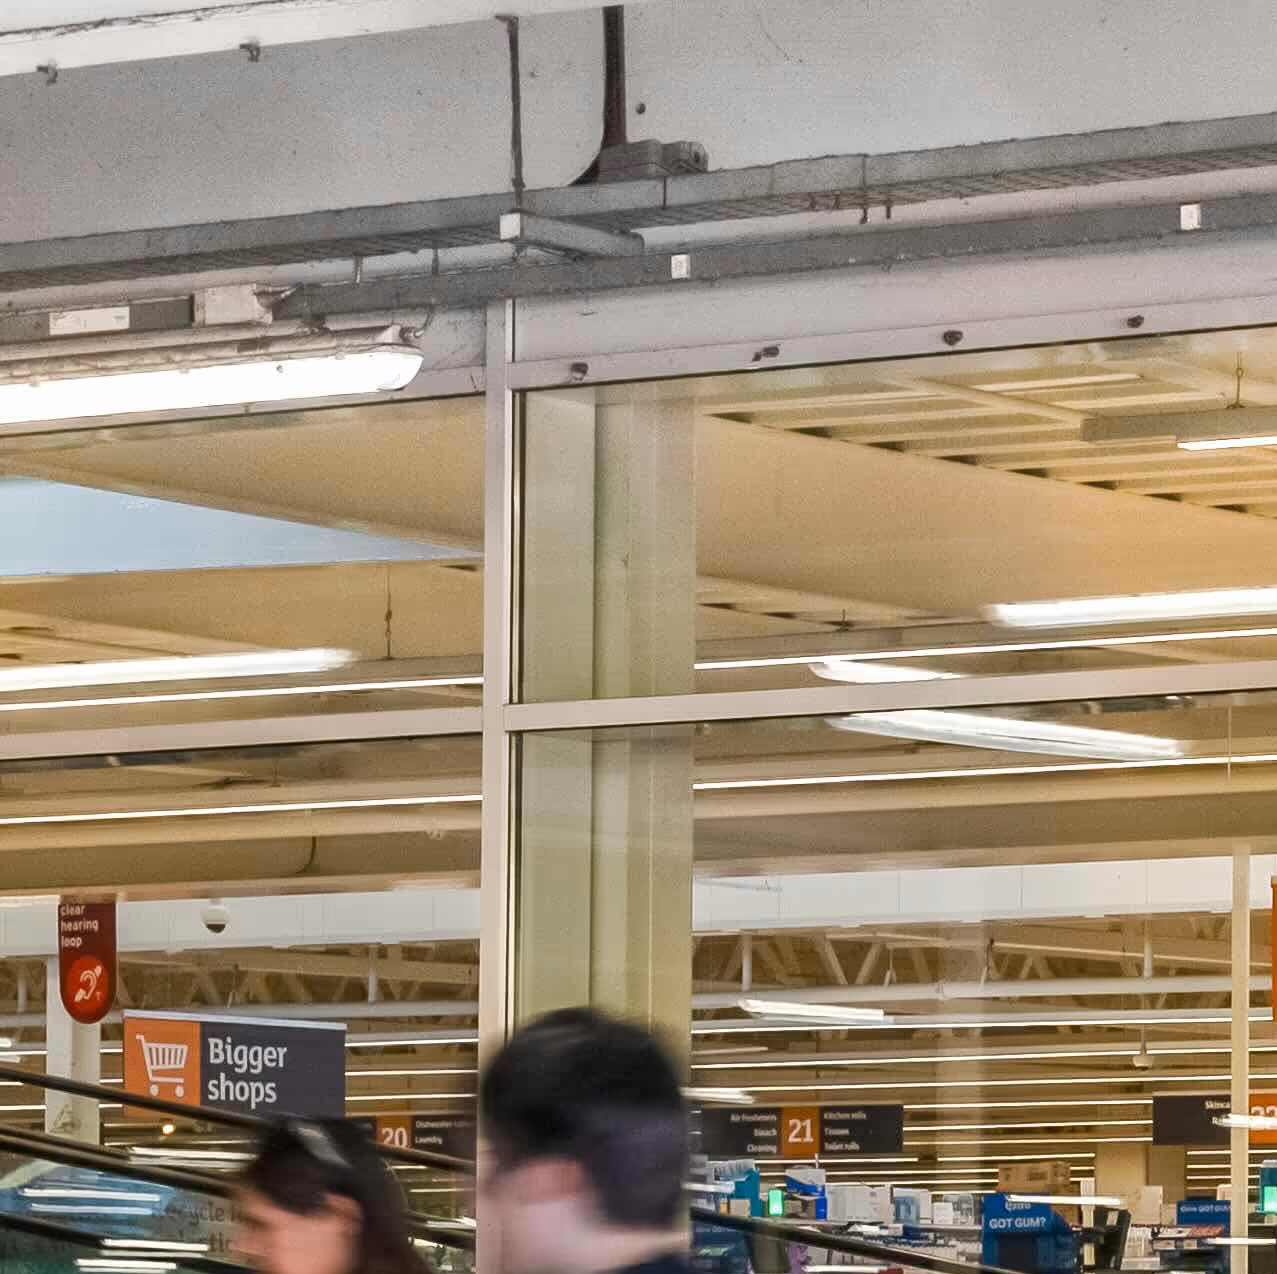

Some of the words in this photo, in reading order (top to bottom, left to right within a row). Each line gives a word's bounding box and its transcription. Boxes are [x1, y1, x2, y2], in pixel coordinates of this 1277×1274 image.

[60, 904, 85, 916] clear
[60, 917, 99, 933] hearing
[60, 935, 82, 949] loop
[207, 1037, 288, 1074] Bigger
[207, 1072, 278, 1110] shops
[382, 1127, 408, 1148] 20
[788, 1118, 814, 1143] 21
[989, 1217, 1013, 1229] GOT
[1014, 1216, 1047, 1228] GUM?
